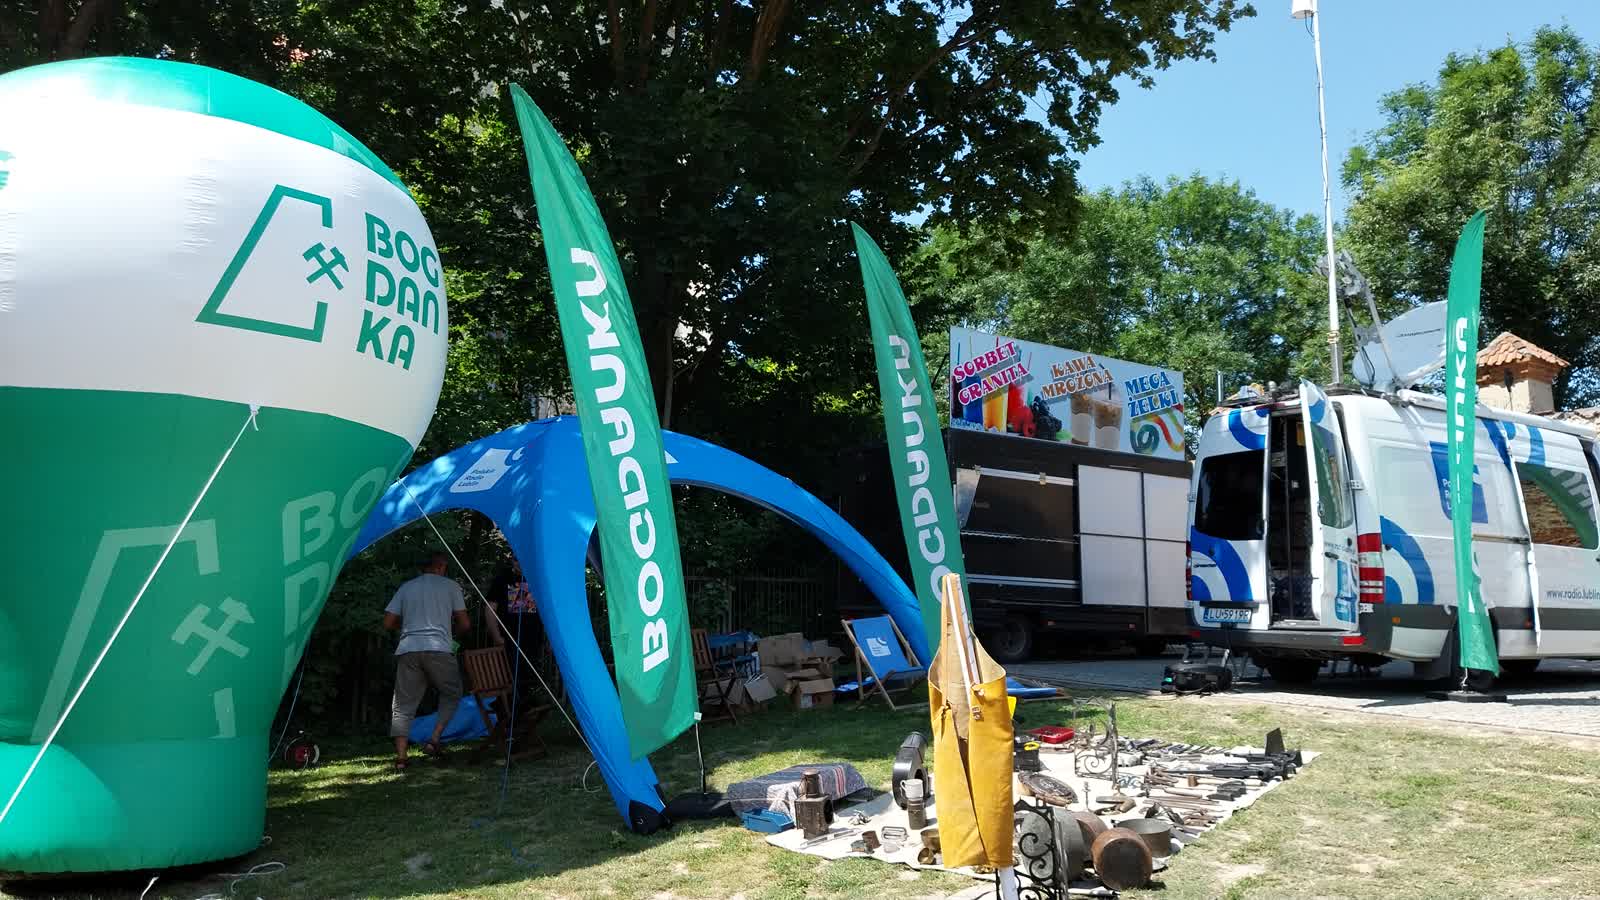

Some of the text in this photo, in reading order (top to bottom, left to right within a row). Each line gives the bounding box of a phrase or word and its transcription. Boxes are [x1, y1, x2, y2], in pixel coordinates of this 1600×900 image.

[365, 212, 439, 288] BOG
[366, 259, 440, 335] DAN
[356, 309, 415, 371] KA
[953, 341, 1017, 382] SORBET
[1051, 356, 1096, 379] KAWA
[958, 362, 1029, 405] GRANITA
[1041, 369, 1113, 400] MROŻONA
[1124, 371, 1172, 397] MEGA
[1127, 389, 1178, 418] ŻELKI
[282, 467, 388, 566] BO
